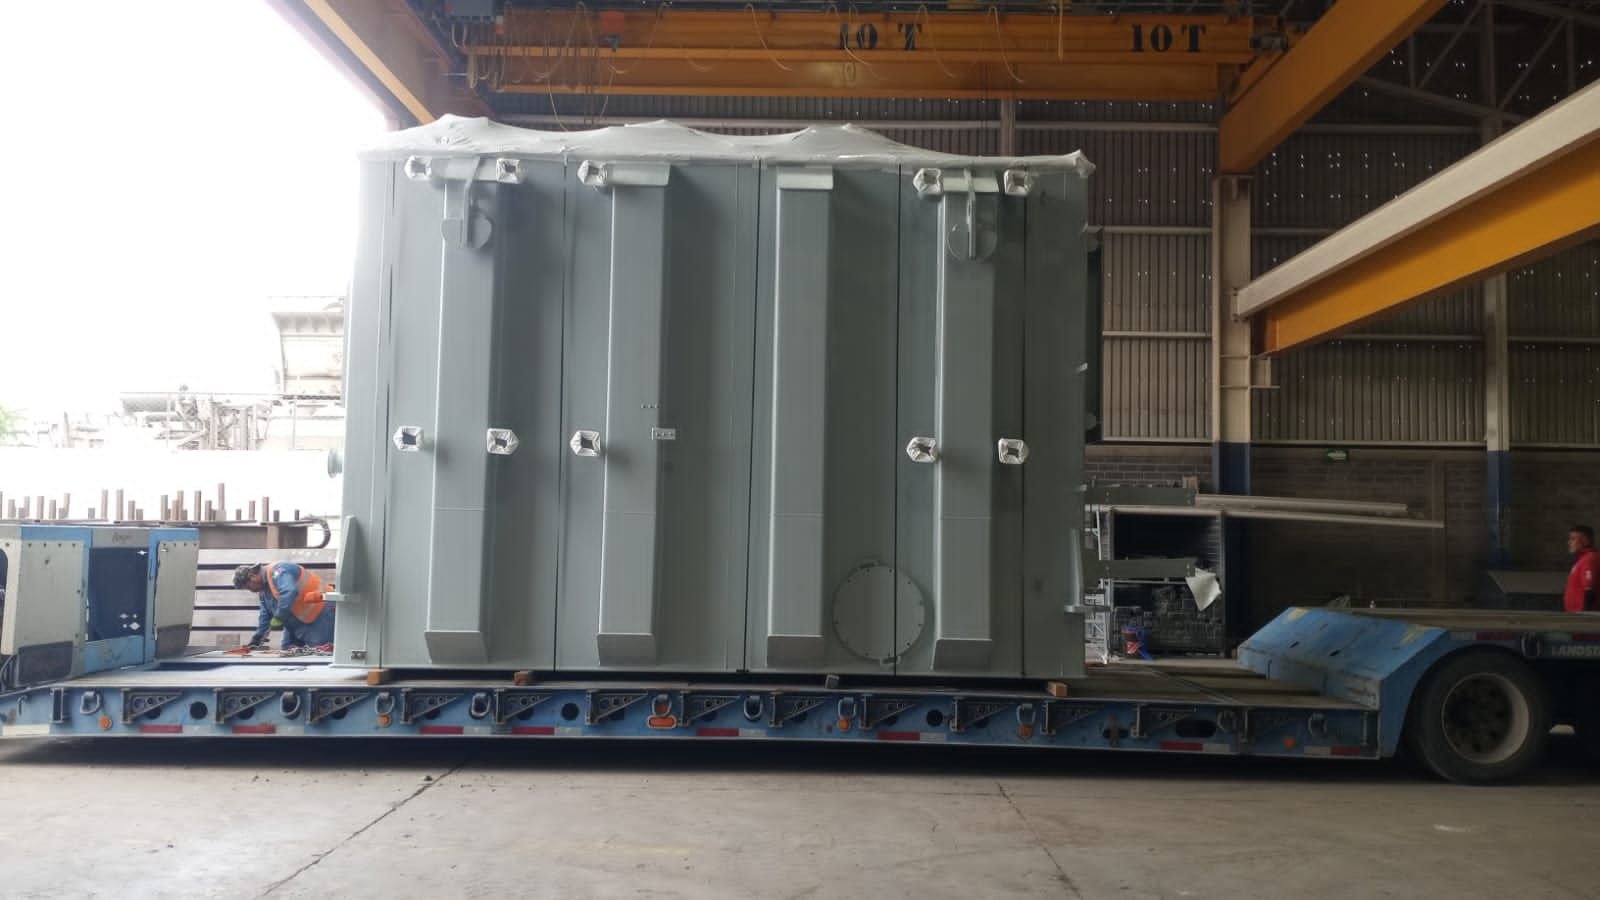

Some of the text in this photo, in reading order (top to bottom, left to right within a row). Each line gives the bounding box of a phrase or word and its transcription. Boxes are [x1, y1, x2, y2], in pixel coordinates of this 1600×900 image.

[839, 23, 922, 51] 10 T
[1130, 24, 1207, 52] 10 T
